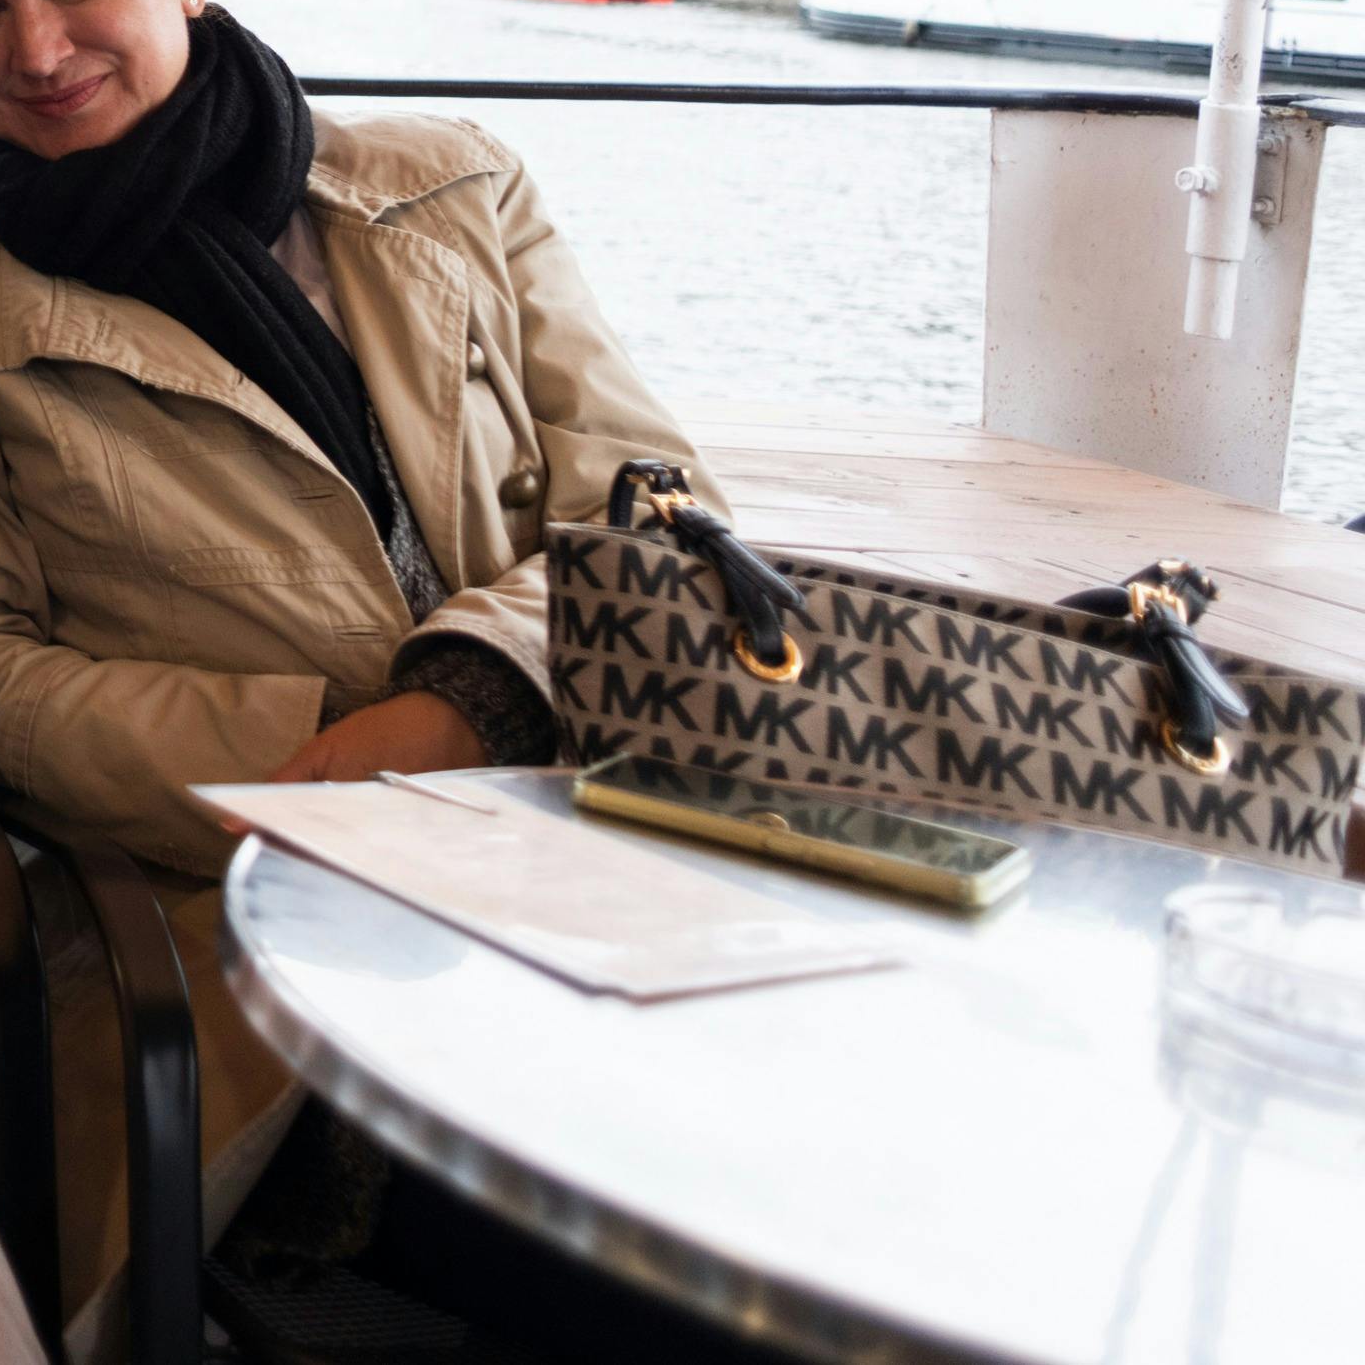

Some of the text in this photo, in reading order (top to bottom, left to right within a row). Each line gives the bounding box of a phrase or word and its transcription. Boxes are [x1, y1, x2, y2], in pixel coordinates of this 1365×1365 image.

[562, 596, 652, 660] MK
[883, 657, 986, 724] MK
[991, 683, 1096, 748] MK
[619, 543, 714, 611] MK
[830, 589, 931, 655] MK
[936, 613, 1034, 681] MK
[1038, 639, 1136, 709] MK
[1242, 682, 1350, 742] MK
[600, 662, 702, 732] MK
[714, 682, 815, 754] MK
[826, 706, 926, 779] MK
[936, 729, 1043, 801] MK
[1049, 750, 1155, 824] MK
[1159, 774, 1259, 847] MK
[1268, 796, 1331, 864] MK
